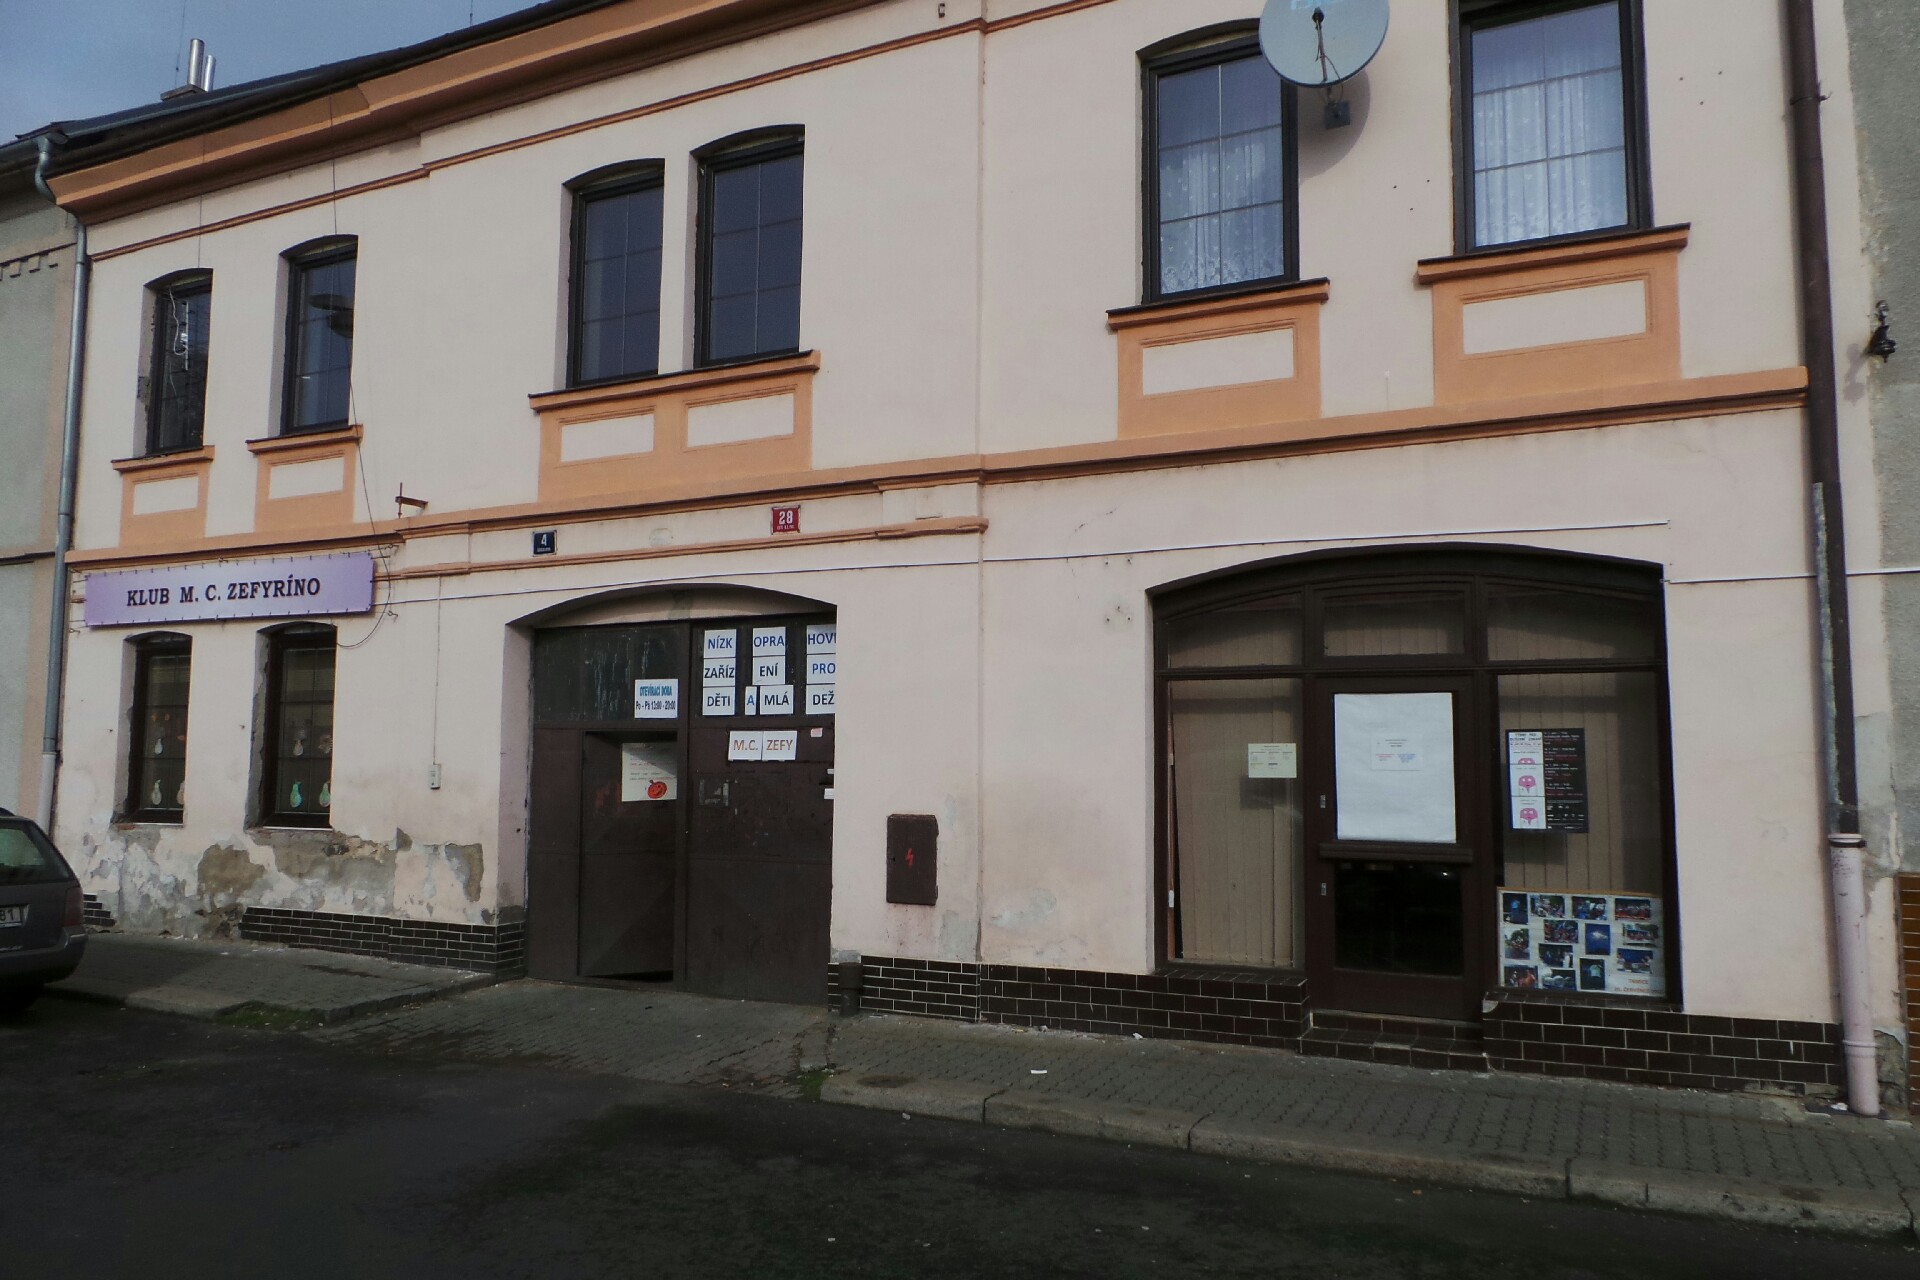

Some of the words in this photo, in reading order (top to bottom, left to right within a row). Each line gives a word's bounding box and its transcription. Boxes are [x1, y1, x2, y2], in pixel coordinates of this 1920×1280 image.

[778, 510, 793, 525] 28
[541, 533, 547, 546] 4
[127, 587, 170, 606] KLUB
[180, 586, 199, 603] M.
[205, 584, 221, 601] C.
[227, 574, 321, 601] ZEFYRÍNO
[707, 635, 733, 649] NÍZK
[753, 633, 785, 648] OPRA
[704, 662, 735, 679] ZAŘÍZ
[759, 663, 778, 677] ENÍ
[812, 663, 836, 675] PRO
[707, 693, 731, 707] DĚTI
[746, 694, 755, 706] A
[764, 691, 790, 706] MLÁ
[812, 690, 835, 706] DEŽ
[733, 739, 759, 751] M.C.
[766, 739, 793, 751] ZEFY
